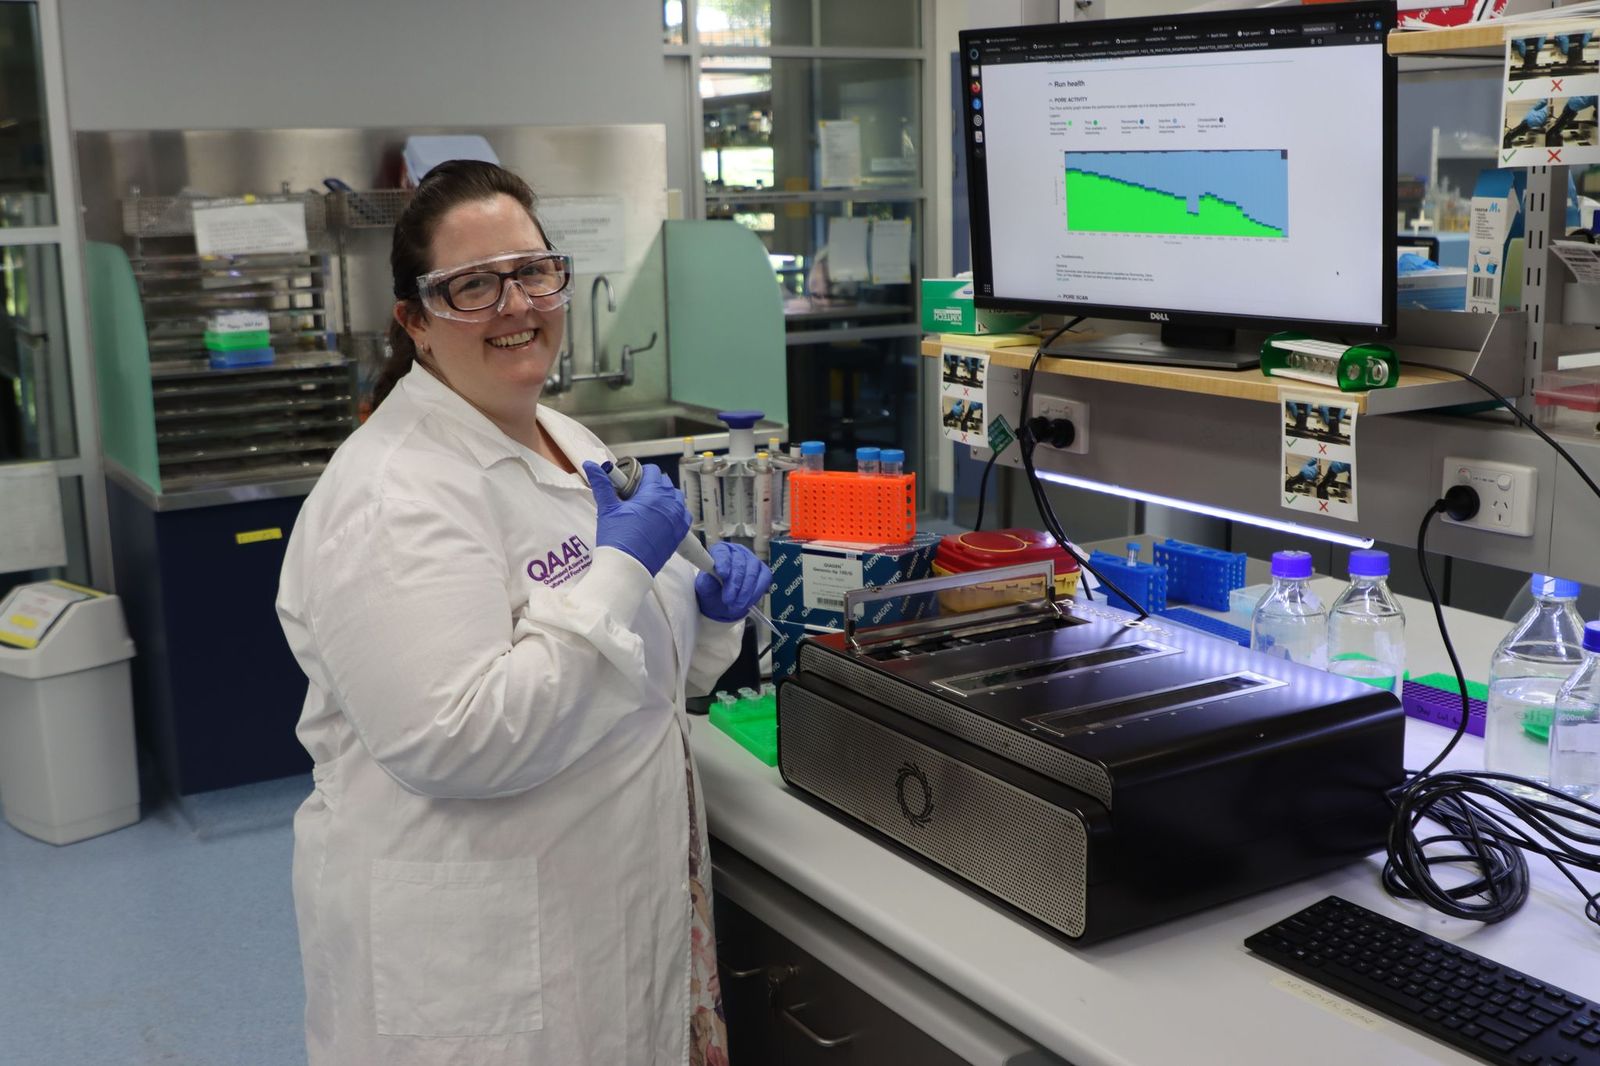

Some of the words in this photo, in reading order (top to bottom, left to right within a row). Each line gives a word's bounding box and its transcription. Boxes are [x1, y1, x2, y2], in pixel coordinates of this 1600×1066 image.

[1150, 312, 1169, 321] DELL
[527, 535, 589, 581] QAAFI
[784, 575, 803, 597] QIAGEN
[872, 601, 893, 623] QIAGEN
